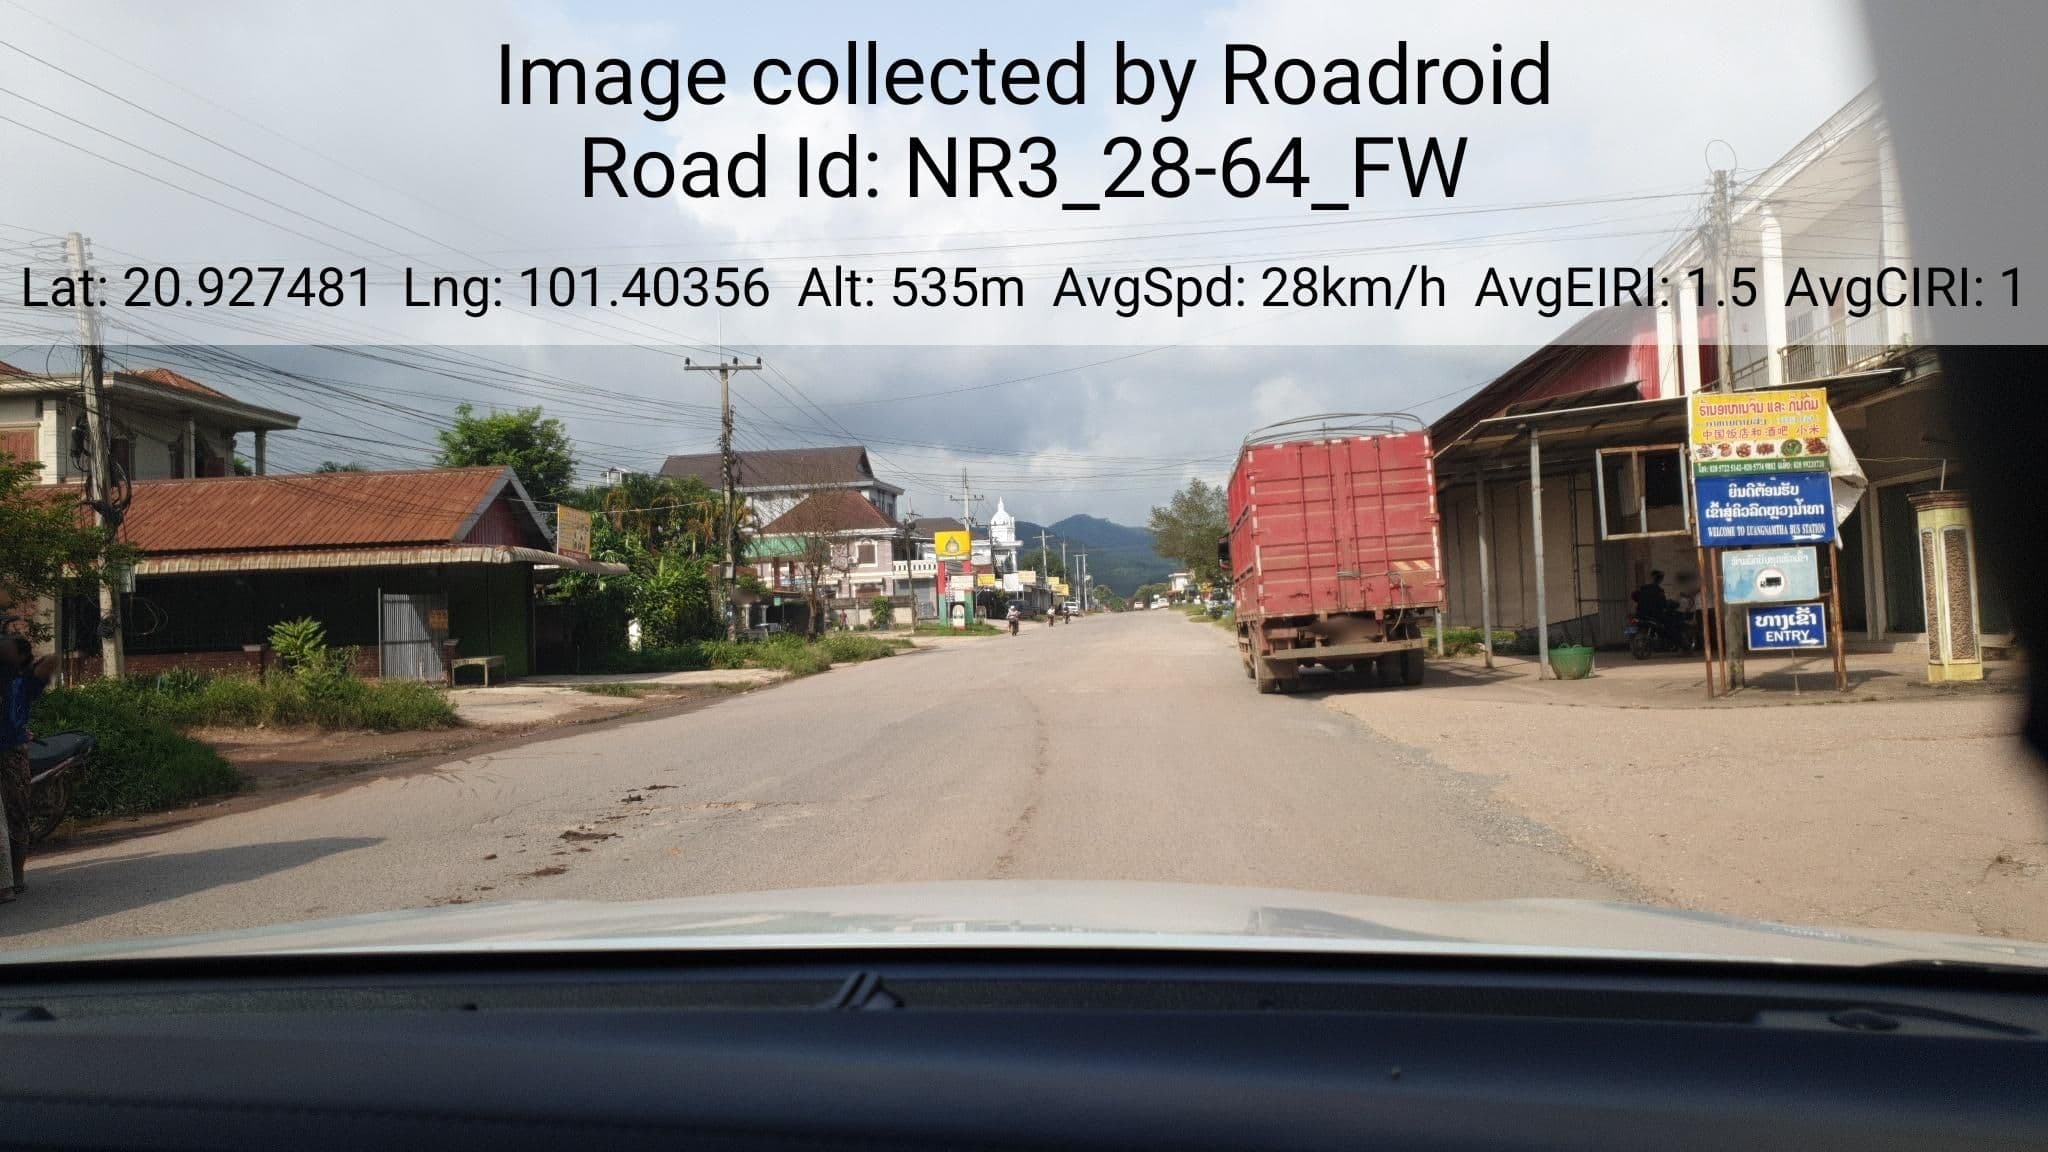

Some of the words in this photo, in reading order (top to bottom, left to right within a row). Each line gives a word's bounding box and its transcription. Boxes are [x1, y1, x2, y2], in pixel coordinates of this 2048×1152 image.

[1796, 424, 1820, 435] 小米
[1707, 525, 1736, 537] WELCOME
[1736, 525, 1745, 536] TO
[1789, 523, 1801, 535] BUS
[1802, 522, 1826, 534] STATION
[1766, 629, 1810, 642] ENTRY
